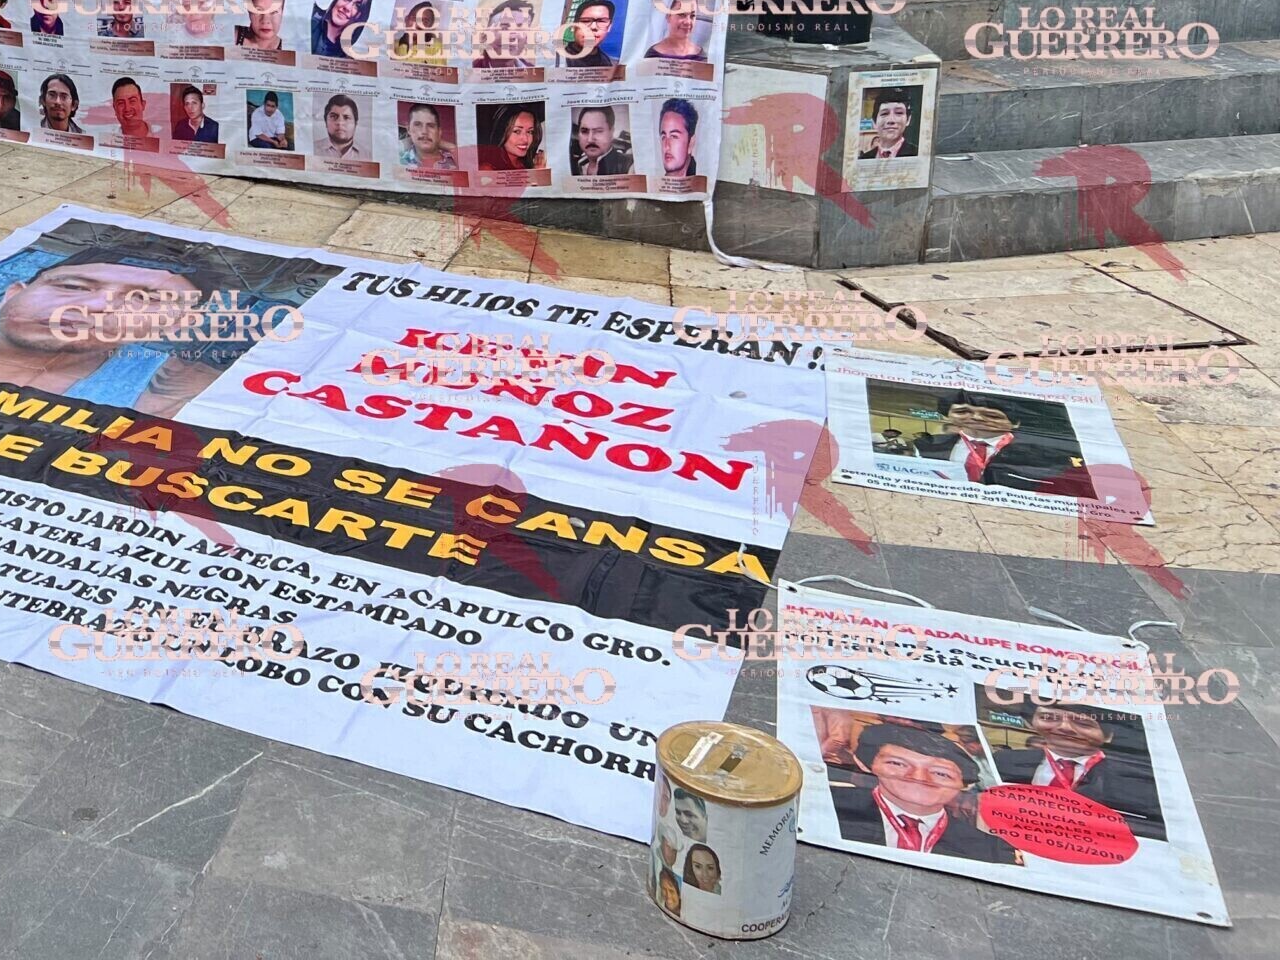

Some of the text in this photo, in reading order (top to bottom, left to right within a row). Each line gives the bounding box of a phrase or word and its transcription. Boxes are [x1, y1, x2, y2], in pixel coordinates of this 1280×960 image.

[342, 271, 421, 298] TUS
[416, 285, 540, 319] HIJOS
[544, 303, 599, 329] TE
[601, 310, 803, 366] ESPERAN
[242, 370, 754, 491] CASTAÑON
[50, 446, 488, 566] BUSCARTE
[197, 437, 312, 477] NO
[333, 469, 443, 509] SE
[465, 493, 771, 584] CANSA
[841, 468, 893, 481] Detenido
[903, 477, 981, 492] desaparecido
[1053, 498, 1126, 515] municipales
[899, 484, 958, 497] diciembre
[960, 491, 979, 499] del
[1009, 498, 1026, 506] en
[67, 507, 187, 547] JARDIN
[185, 538, 321, 584] AZTECA,
[328, 571, 381, 597] EN
[381, 587, 574, 642] ACAPULCO
[583, 632, 671, 667] GRO.
[107, 542, 192, 575] AZUL
[199, 565, 270, 591] CON
[269, 580, 482, 646] ESTAMPADO
[157, 580, 298, 625] NEGRAS
[402, 700, 459, 724] SU
[988, 828, 1020, 838] GRO
[1024, 833, 1043, 844] EL
[991, 809, 1116, 840] MUNICIPALES EN
[1018, 807, 1087, 827] POLICÍAS
